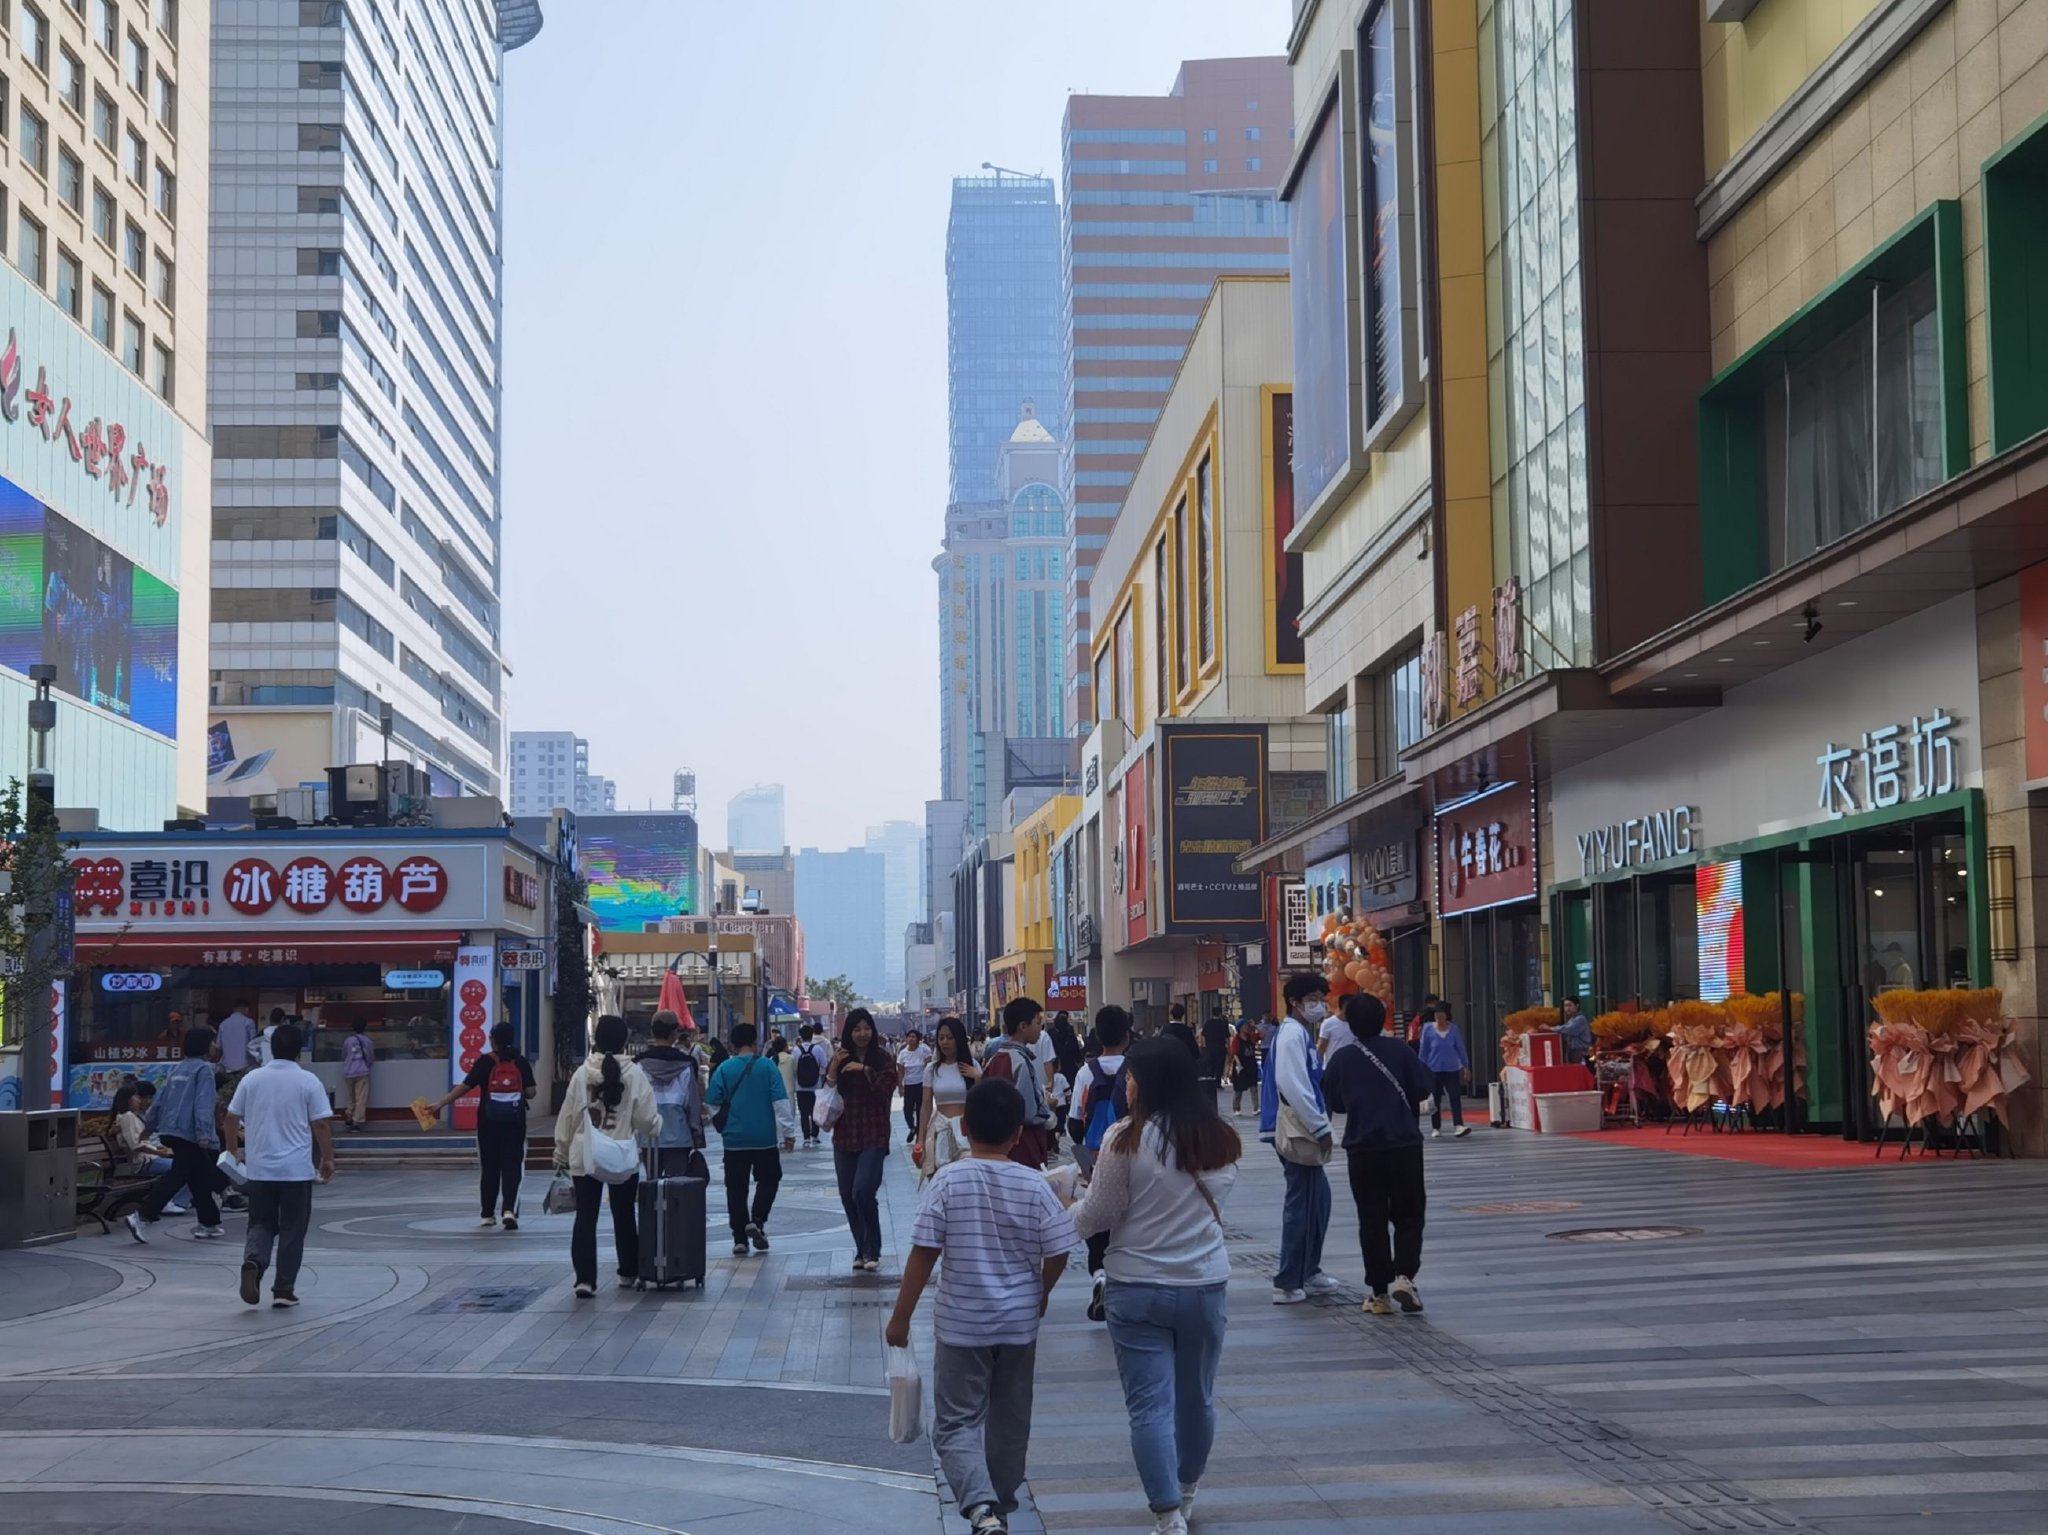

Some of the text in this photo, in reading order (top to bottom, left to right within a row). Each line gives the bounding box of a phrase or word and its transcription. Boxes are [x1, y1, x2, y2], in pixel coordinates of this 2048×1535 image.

[25, 365, 169, 528] 女人世界广场
[1816, 707, 1954, 820] 衣语坊
[1576, 805, 1692, 878] YIYUFANG
[130, 860, 209, 900] 喜识
[230, 863, 438, 905] 冰糖葫芦
[129, 901, 209, 916] XISHI
[617, 965, 658, 979] GEE
